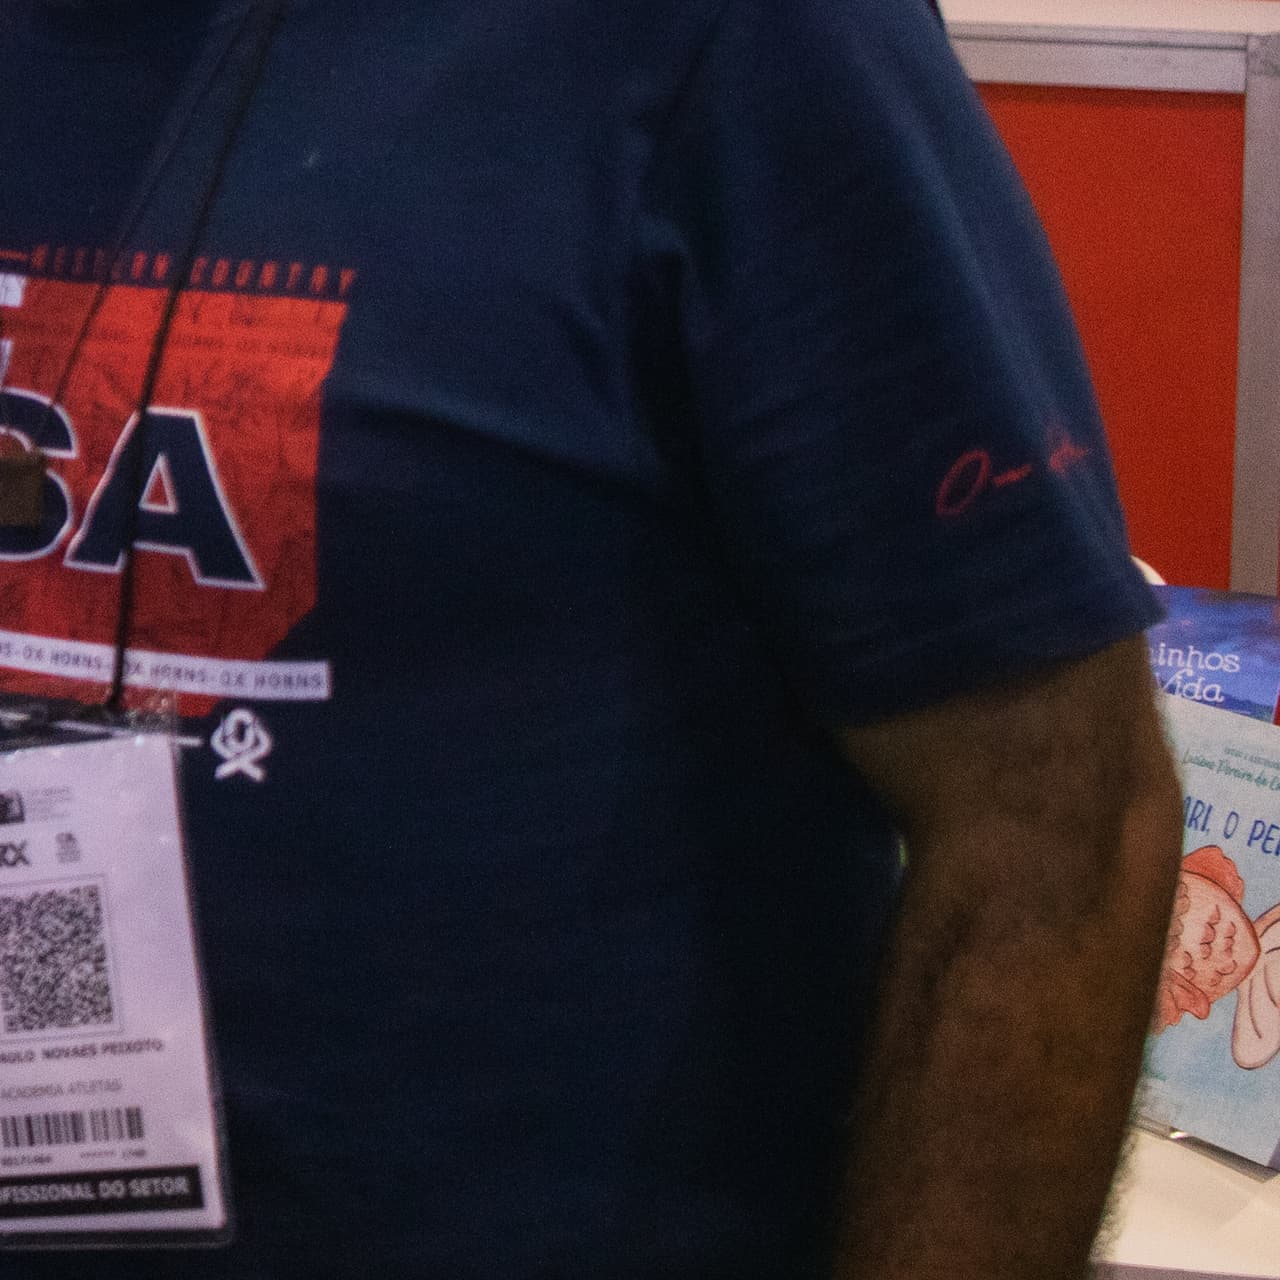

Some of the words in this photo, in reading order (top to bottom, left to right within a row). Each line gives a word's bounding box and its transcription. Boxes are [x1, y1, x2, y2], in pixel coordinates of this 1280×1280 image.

[42, 1043, 98, 1060] NOVAES
[101, 1038, 164, 1055] PEIXOTO
[99, 1179, 125, 1198] DO
[128, 1175, 190, 1198] SETOR
